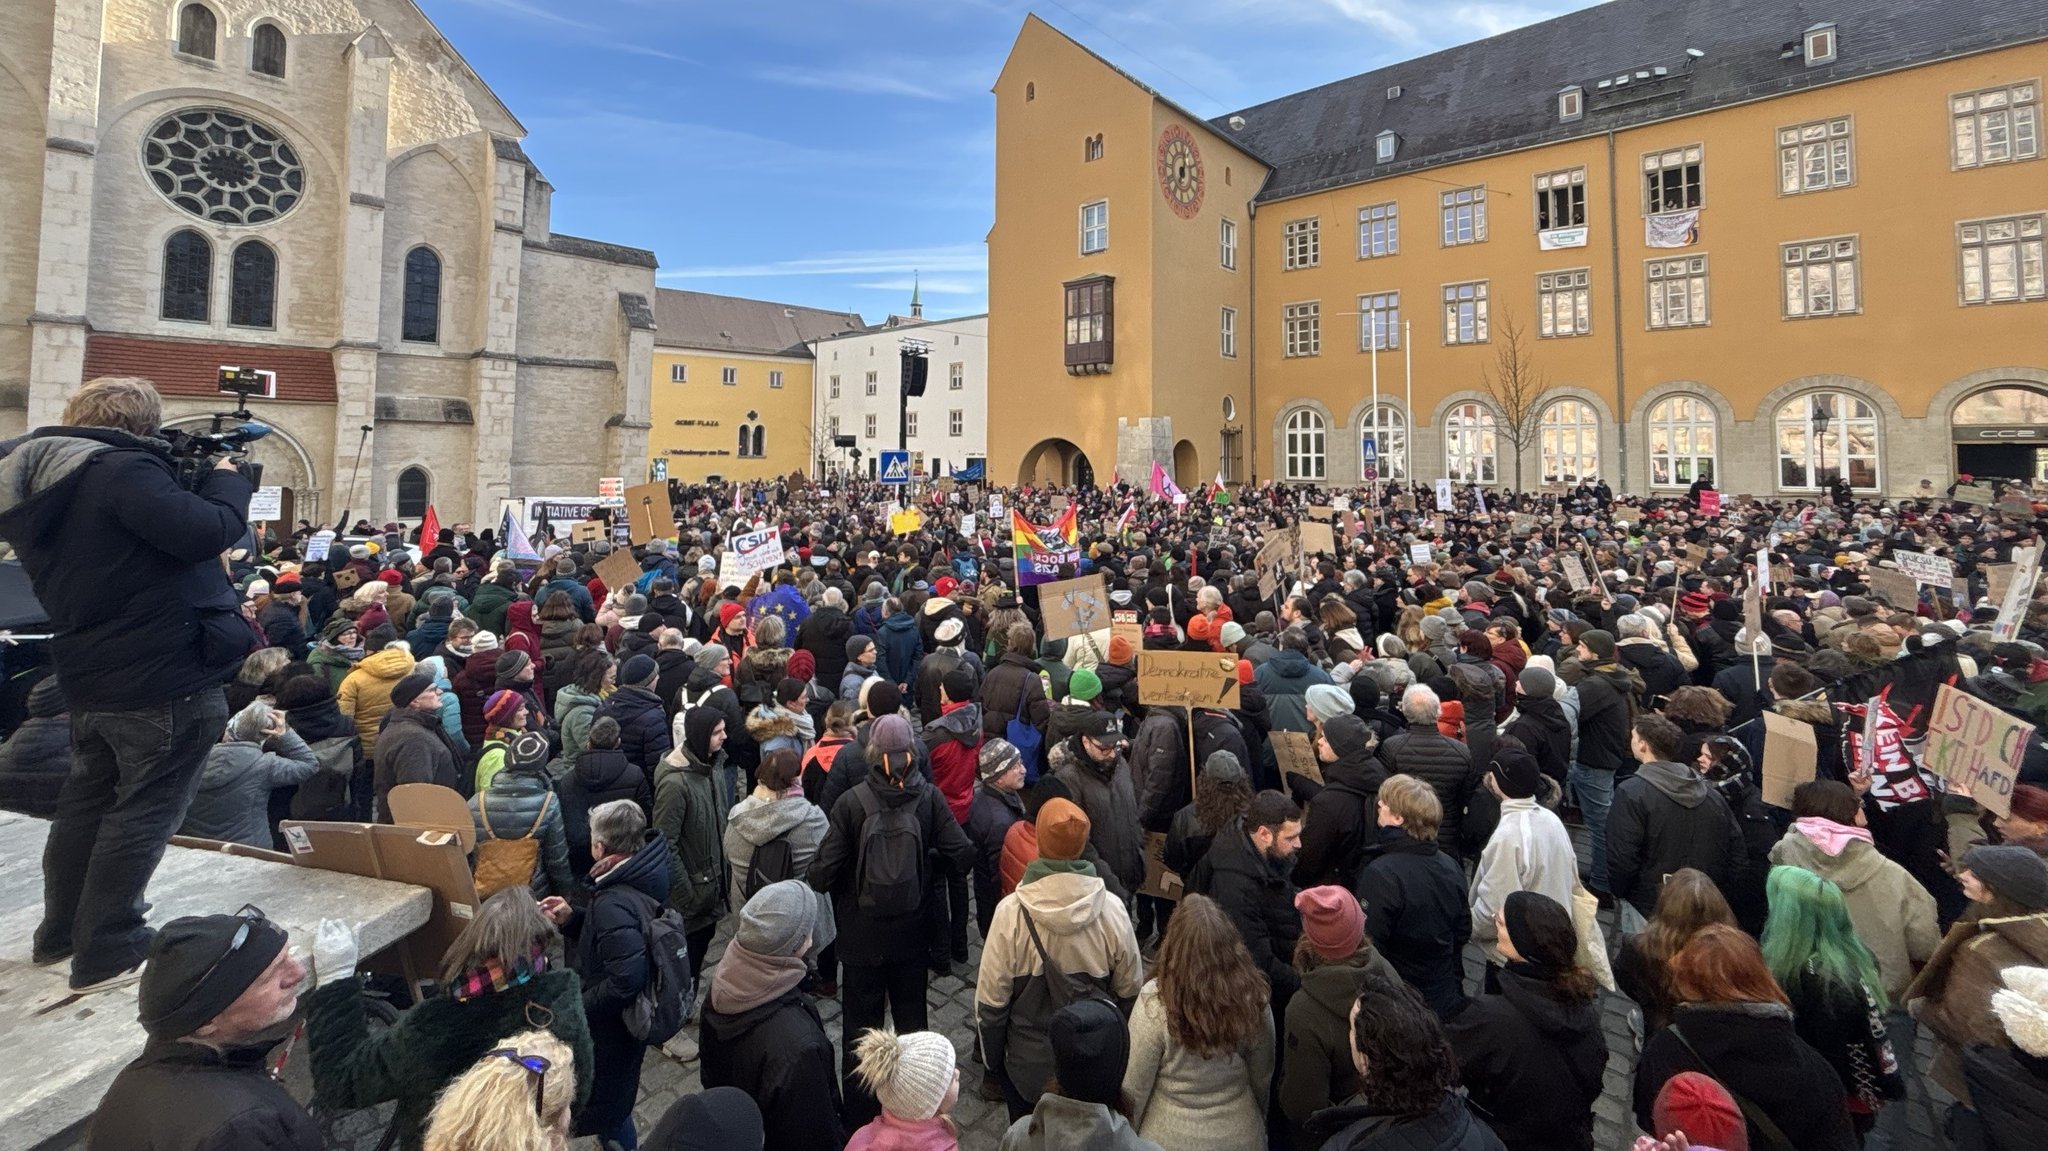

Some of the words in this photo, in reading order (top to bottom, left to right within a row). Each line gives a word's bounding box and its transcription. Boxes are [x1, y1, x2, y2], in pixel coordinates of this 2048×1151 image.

[534, 505, 578, 518] INTIATIVE
[735, 532, 769, 554] CSU
[1140, 654, 1222, 679] Demokratie
[1936, 688, 1977, 739] IST
